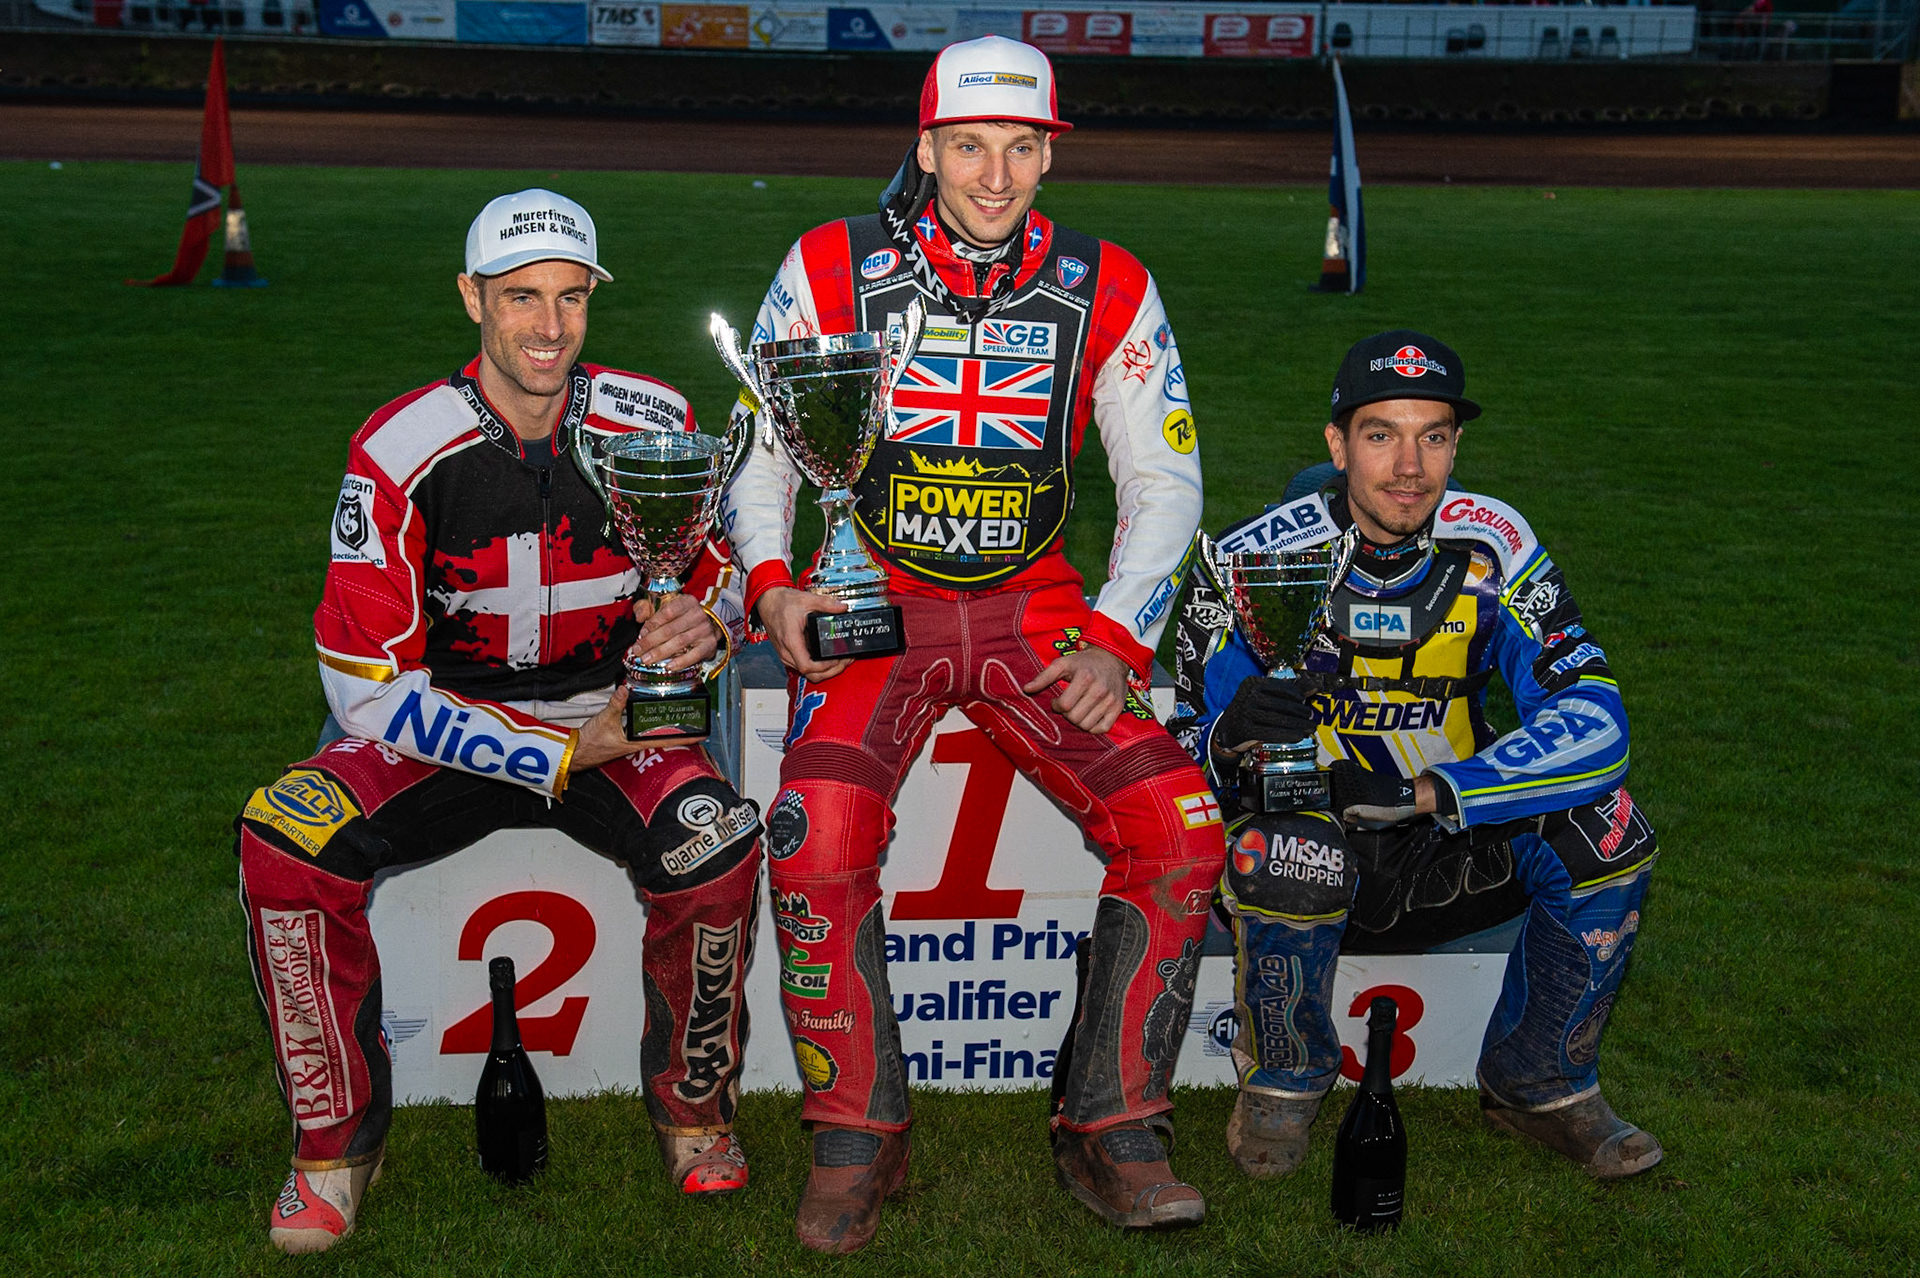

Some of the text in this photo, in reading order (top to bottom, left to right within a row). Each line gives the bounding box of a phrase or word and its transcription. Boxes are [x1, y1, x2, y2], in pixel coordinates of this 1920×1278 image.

[597, 7, 638, 25] TMS
[963, 75, 1035, 87] Allied Vehicles
[513, 209, 576, 227] Murerfirma
[500, 222, 588, 245] HANSEN & KRUSE
[863, 252, 890, 271] ACU
[1060, 259, 1084, 274] SGB
[924, 330, 967, 341] Mobility
[983, 344, 1049, 355] SPEEDWAY TEAM
[1006, 324, 1049, 347] GB
[1370, 358, 1385, 371] NJ
[599, 382, 629, 400] JØRGEN
[629, 390, 651, 406] HOLM
[615, 401, 635, 417] FANØ
[645, 409, 674, 431] ESBJERG
[896, 482, 1024, 518] POWER
[895, 512, 1022, 554] MAXED
[1142, 578, 1174, 628] Allied
[1425, 585, 1444, 612] Securing
[1354, 612, 1406, 632] GPA
[1311, 695, 1449, 731] SWEDEN
[383, 689, 549, 784] Nice
[1493, 710, 1608, 768] GPA
[278, 782, 345, 825] HELLA
[245, 806, 321, 854] SERVICE PARTNER
[889, 727, 1025, 920] 1
[664, 833, 715, 872] bjarne
[1269, 860, 1344, 888] GRUPPEN
[884, 919, 1090, 963] and Prix
[439, 890, 596, 1057] 2
[782, 968, 827, 988] CK OIL
[890, 979, 1061, 1023] ualifier
[801, 1009, 855, 1034] Family
[1340, 984, 1424, 1083] 3
[903, 1039, 1057, 1081] mi-Fina
